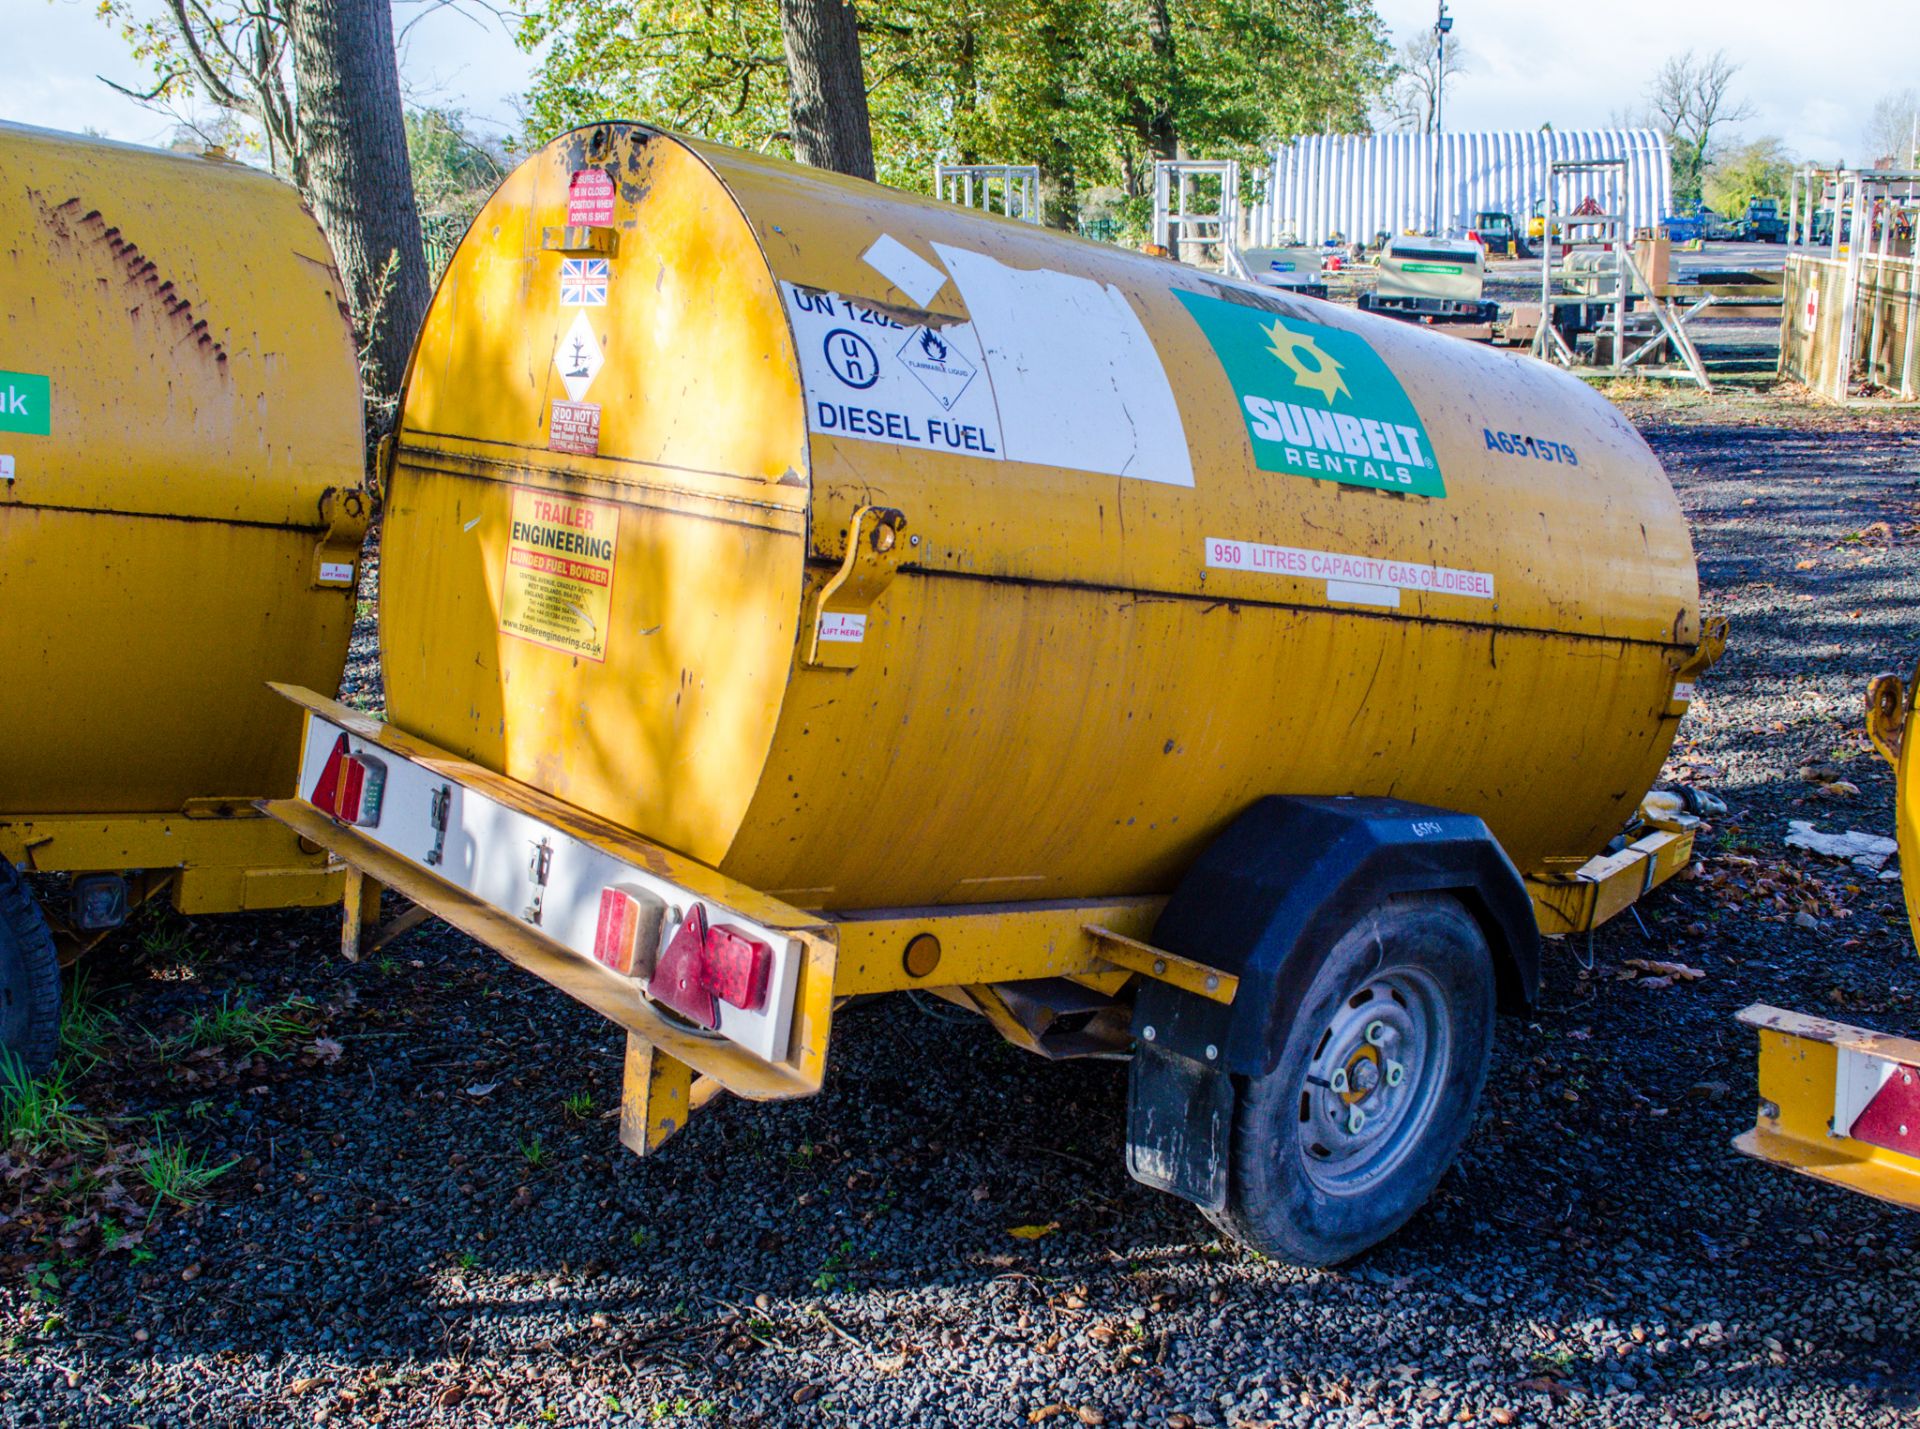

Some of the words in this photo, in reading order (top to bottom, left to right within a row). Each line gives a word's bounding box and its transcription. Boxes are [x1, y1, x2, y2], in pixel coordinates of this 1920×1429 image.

[570, 200, 595, 209] POSITION
[596, 200, 613, 208] WHEN
[588, 187, 610, 196] CLOSED
[571, 212, 587, 222] DOOR
[594, 212, 610, 222] SHUT
[793, 288, 835, 316] UN
[908, 360, 947, 374] FLAMMABLE
[948, 368, 968, 376] LIQUID
[560, 408, 572, 420] DO
[574, 410, 592, 422] NOT
[943, 396, 950, 406] 3
[578, 425, 588, 434] OIL
[817, 401, 920, 442] DIESEL
[927, 419, 996, 453] FUEL
[1243, 394, 1425, 467] SUNBELT
[1483, 428, 1578, 466] A651579
[1284, 447, 1412, 484] RENTALS
[534, 500, 594, 530] TRAILER
[512, 521, 612, 561] ENGINEERING
[512, 550, 544, 570] BUNDED
[546, 558, 568, 574] FUEL
[570, 563, 608, 584] BOWSER
[1214, 543, 1242, 564] 950
[1252, 548, 1308, 572] LITRES
[1311, 555, 1384, 582] CAPACITY
[1388, 566, 1417, 584] GAS
[822, 628, 838, 636] LIFT
[840, 629, 860, 637] HERE
